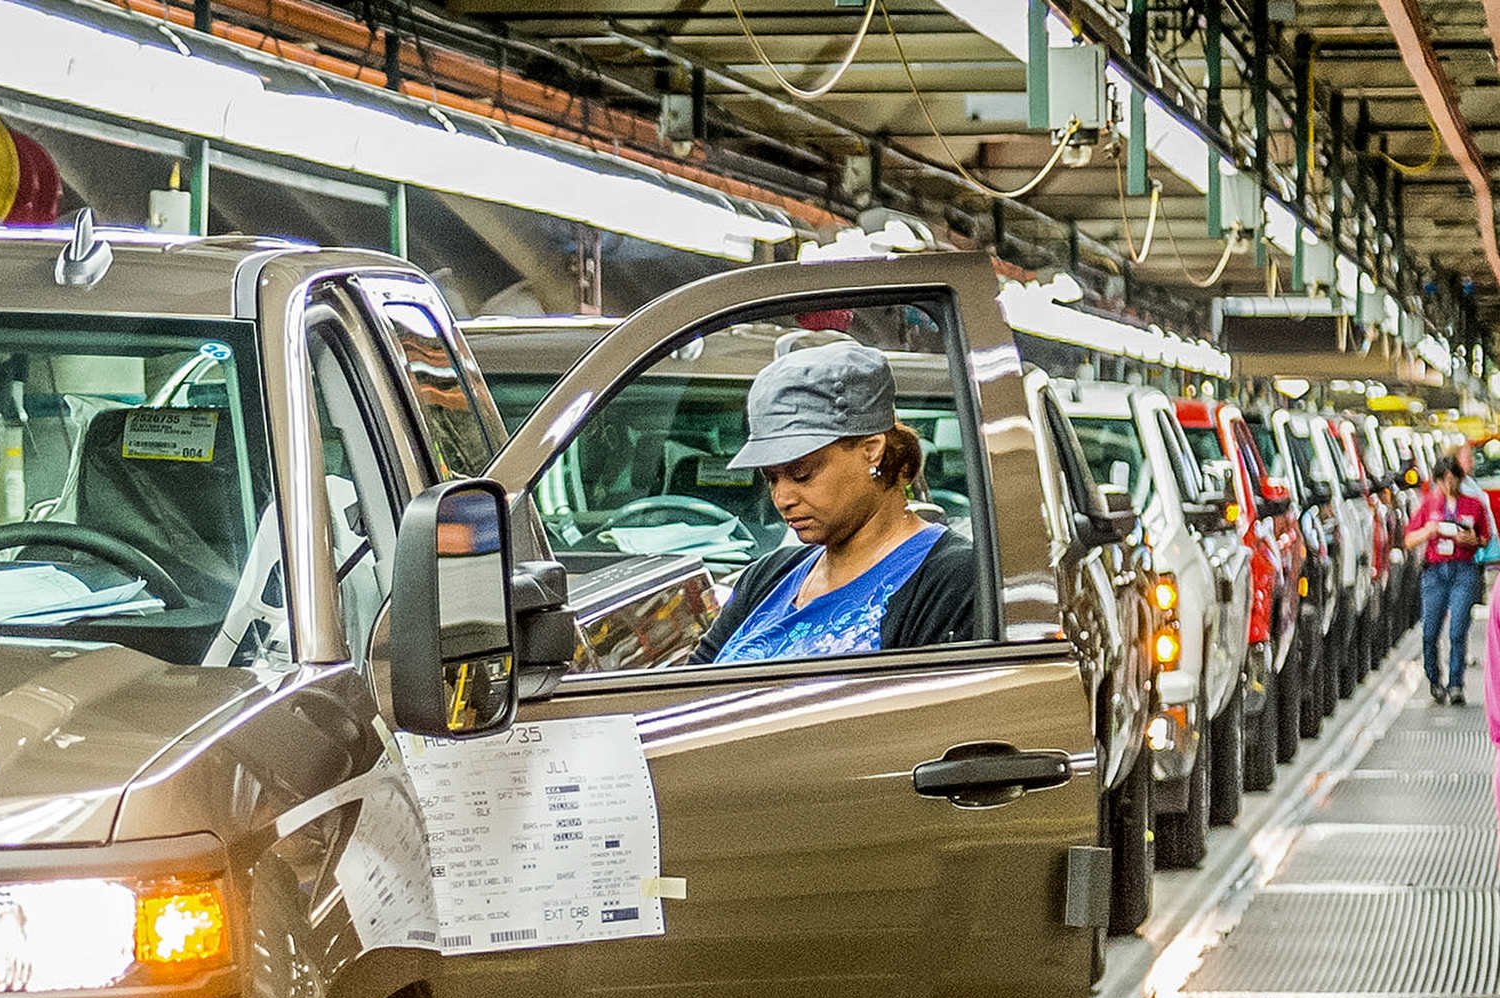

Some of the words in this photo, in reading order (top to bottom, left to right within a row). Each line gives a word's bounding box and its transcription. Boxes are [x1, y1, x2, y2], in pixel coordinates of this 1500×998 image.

[203, 344, 227, 358] 26
[182, 447, 203, 459] 004
[546, 760, 569, 774] JL1
[544, 908, 564, 921] EXT
